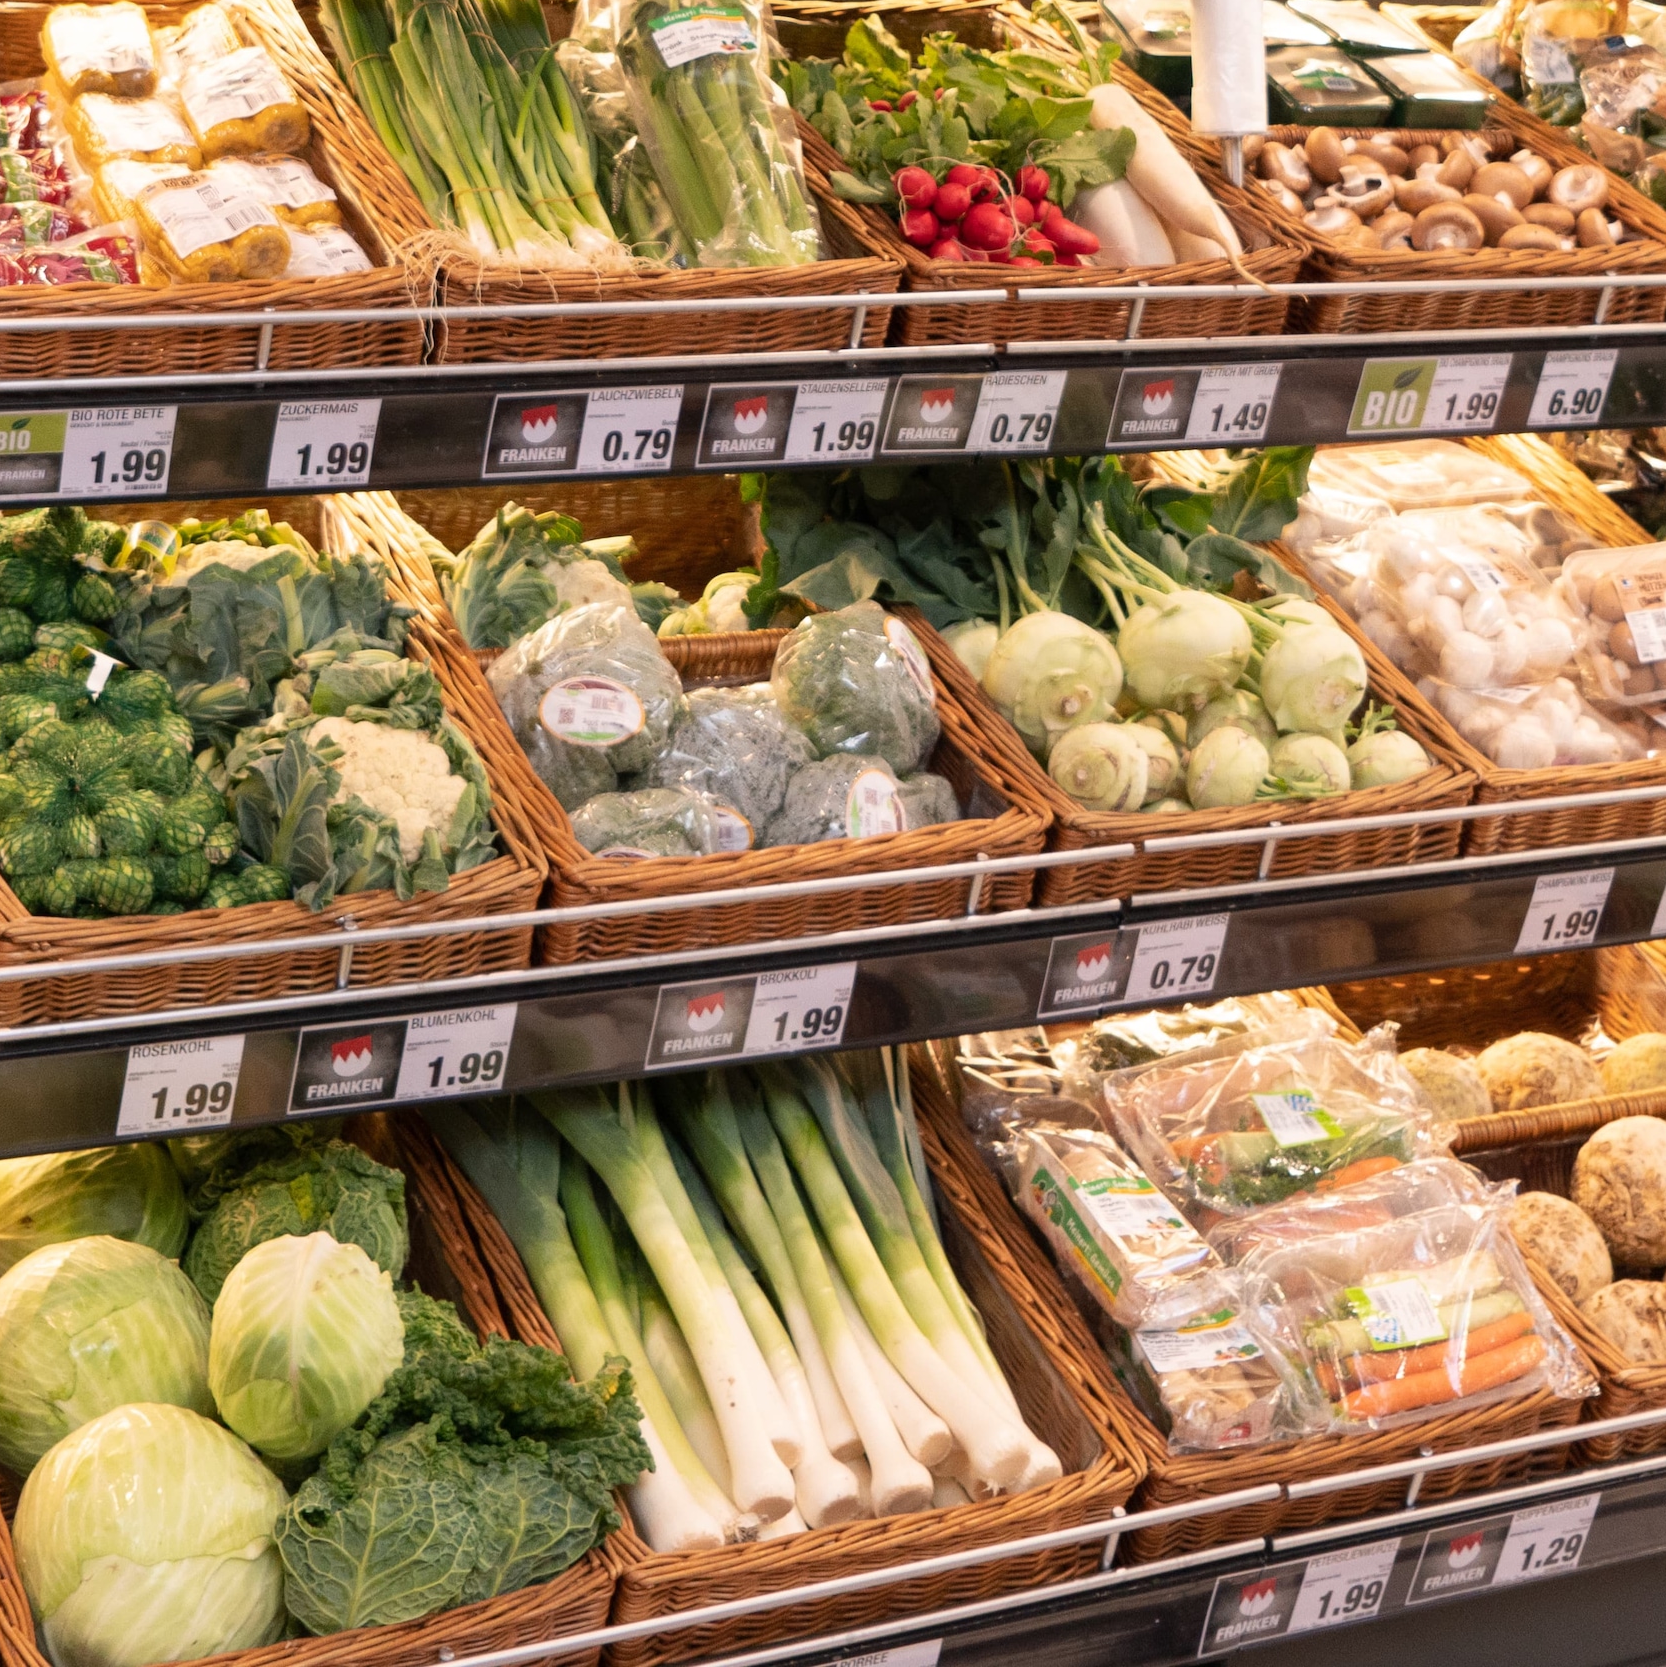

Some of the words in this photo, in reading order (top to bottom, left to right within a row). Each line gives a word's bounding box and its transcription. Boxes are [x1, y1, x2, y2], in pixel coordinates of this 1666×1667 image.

[985, 374, 1047, 386] RADIESCHEN
[1203, 366, 1235, 378] RETTICH
[1237, 366, 1253, 377] MIT
[1255, 365, 1281, 376] GRUEN
[591, 387, 682, 402] LAUCHZWIEBELN
[800, 380, 887, 394] STAUDENSELLERIE
[71, 408, 93, 422] BIO
[96, 408, 130, 422] ROTE
[133, 407, 165, 421] BETE
[280, 402, 359, 415] ZUCKERMAIS
[1362, 390, 1419, 427] BIO
[1445, 392, 1498, 421] 1.99
[1548, 387, 1602, 417] 6.90
[990, 413, 1053, 443] 0.79
[1121, 419, 1178, 434] FRANKEN
[1211, 403, 1268, 432] 1.49
[603, 428, 671, 462] 0.79
[711, 438, 776, 453] FRANKEN
[812, 421, 877, 452] 1.99
[898, 427, 958, 442] FRANKEN
[91, 449, 166, 484] 1.99
[297, 441, 371, 477] 1.99
[499, 447, 566, 462] FRANKEN
[0, 469, 46, 481] FRANKEN
[1142, 921, 1194, 936] KOHLRABI
[1196, 915, 1228, 929] WEISS
[1542, 908, 1599, 941] 1.99
[760, 968, 818, 986] BROKKOLI
[1150, 953, 1216, 990] 0.79
[1054, 980, 1117, 1003] FRANKEN
[411, 1009, 497, 1030] BLUMENKOHL
[774, 1005, 844, 1042] 1.99
[132, 1040, 214, 1059] ROSENKOHL
[663, 1032, 733, 1054] FRANKEN
[428, 1049, 503, 1089] 1.99
[152, 1080, 233, 1119] 1.99
[307, 1076, 382, 1099] FRANKEN
[1515, 1495, 1591, 1523] SUPPENGRUEN
[1521, 1533, 1583, 1571] 1.29
[1423, 1566, 1486, 1593] FRANKEN
[1318, 1579, 1384, 1620] 1.99
[1215, 1614, 1281, 1641] FRANKEN
